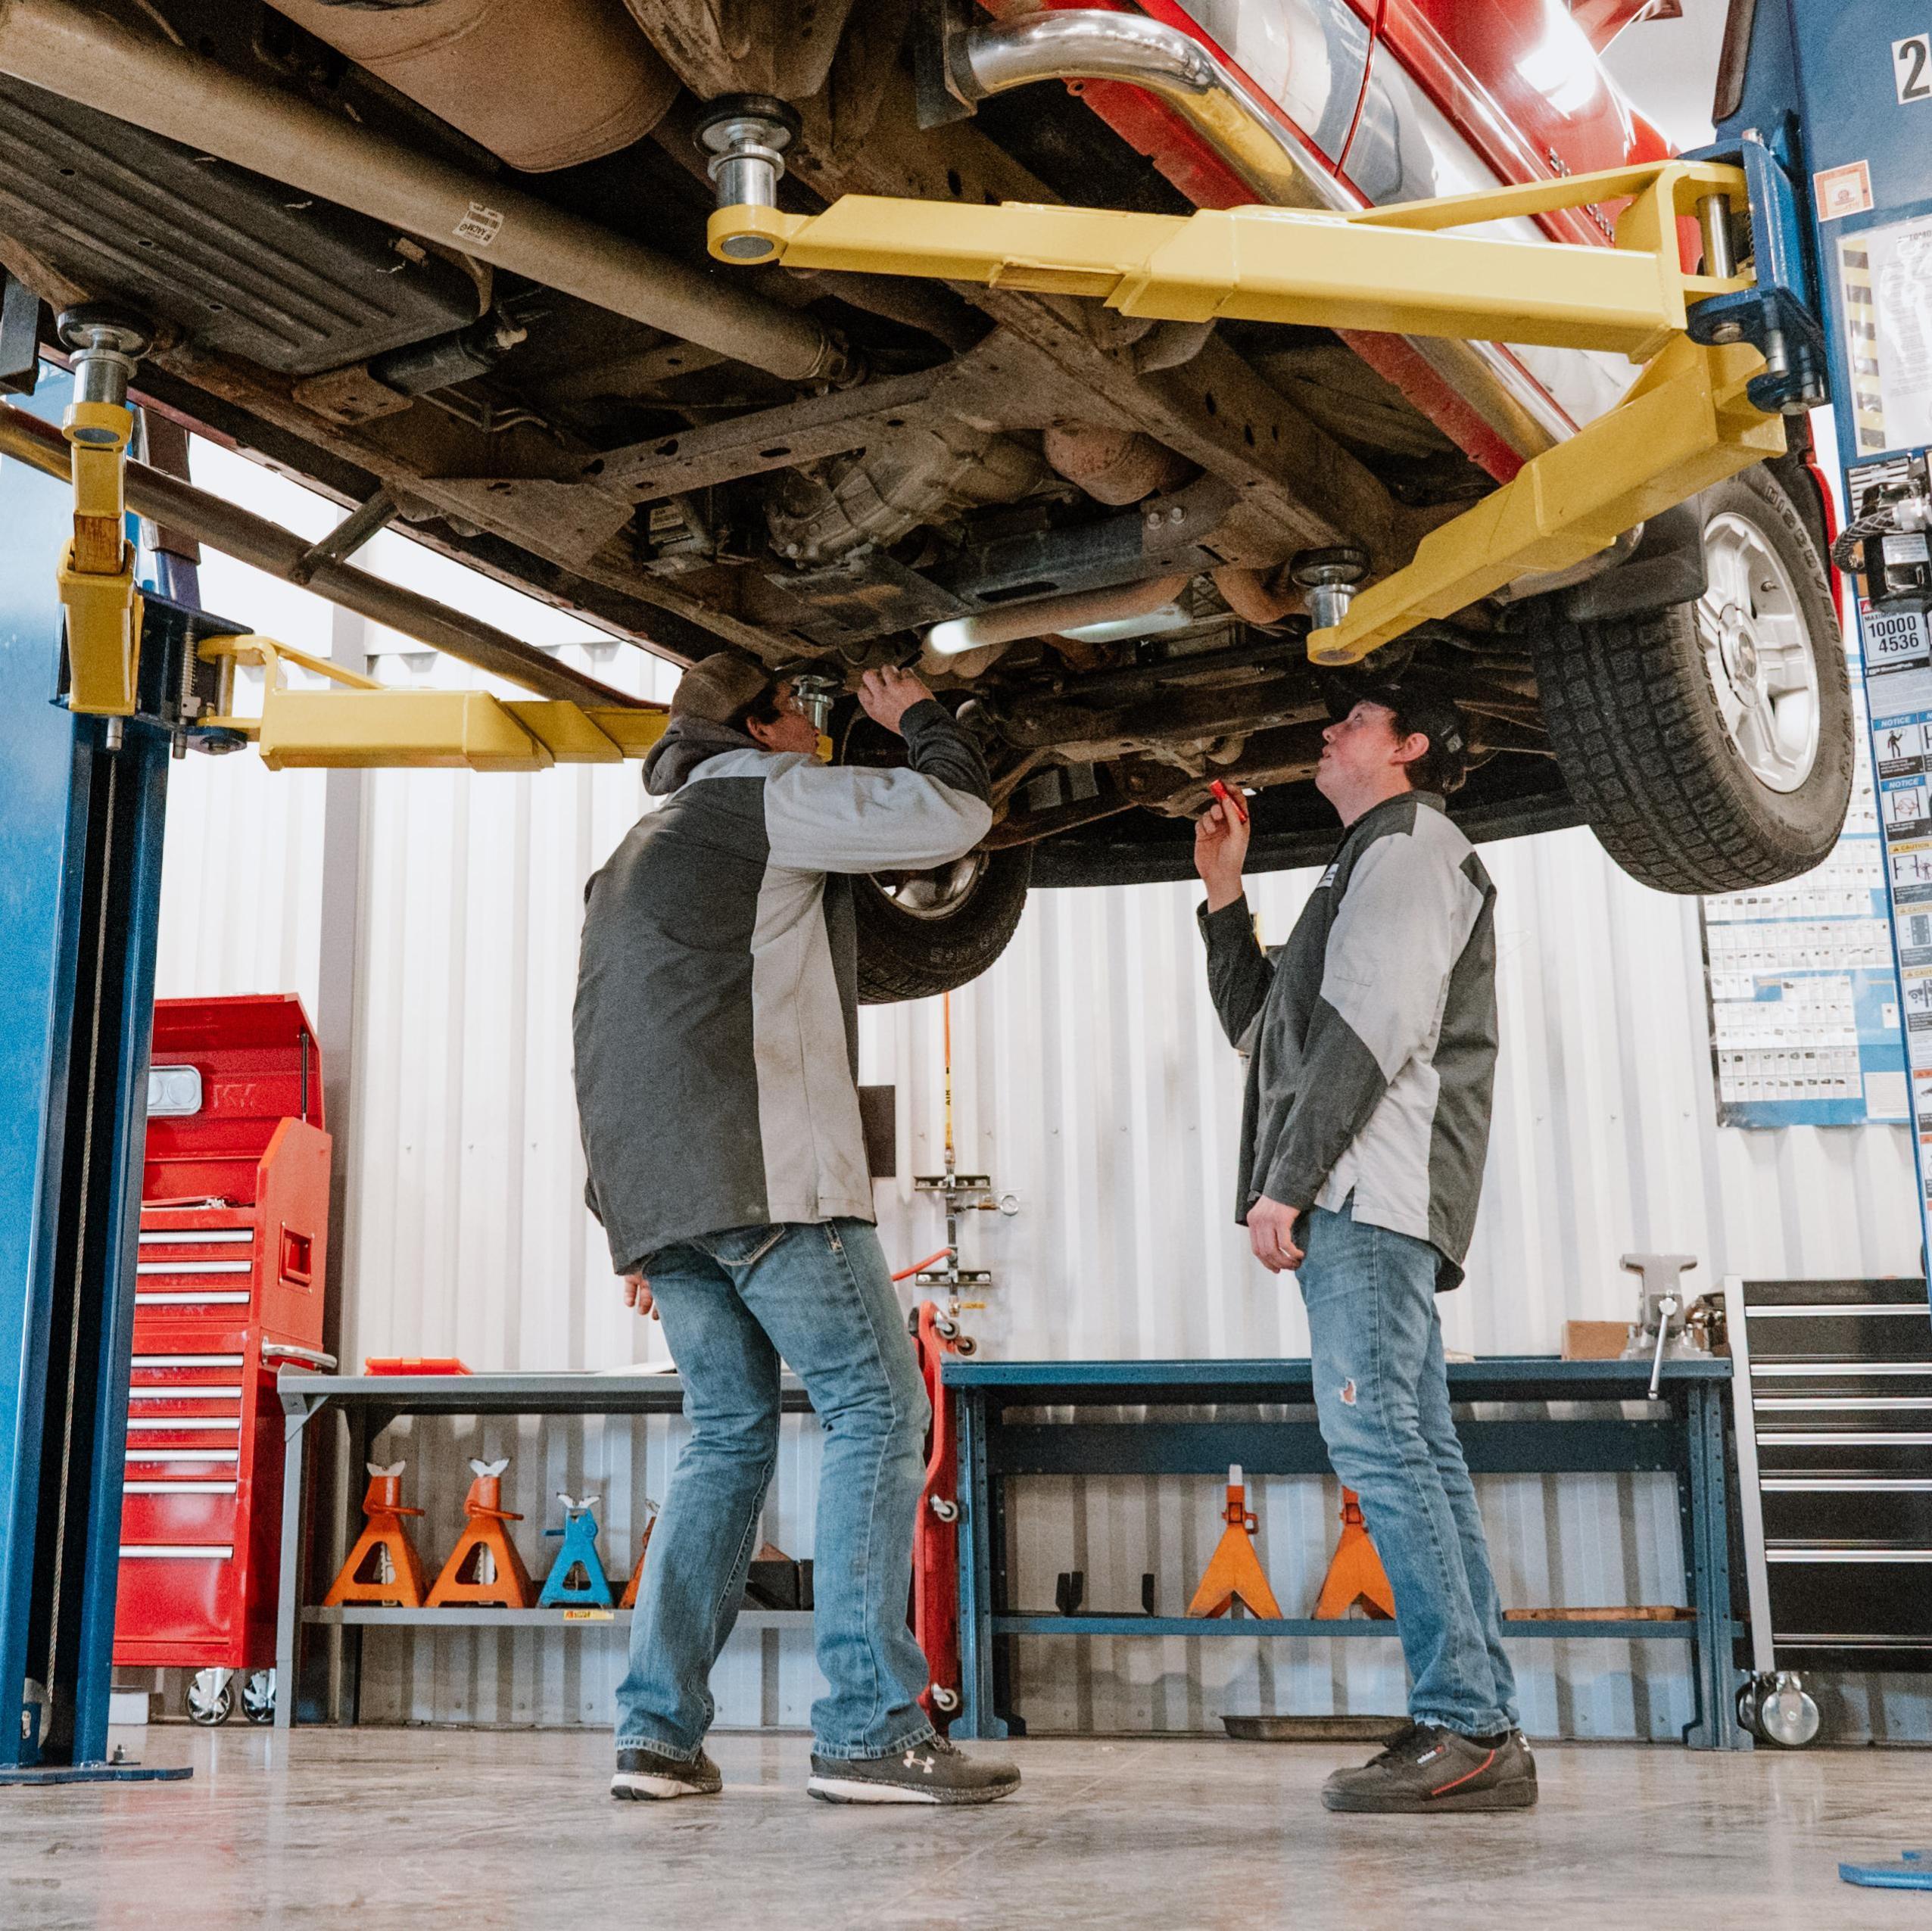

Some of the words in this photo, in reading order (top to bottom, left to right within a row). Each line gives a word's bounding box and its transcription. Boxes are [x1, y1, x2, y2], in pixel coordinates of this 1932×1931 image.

[1899, 39, 1930, 100] 2
[1868, 615, 1916, 637] 10000
[1879, 632, 1919, 652] 4536
[1881, 715, 1911, 727] NOTICE
[1889, 777, 1919, 789] NOTICE
[1901, 841, 1929, 851] CAUTION
